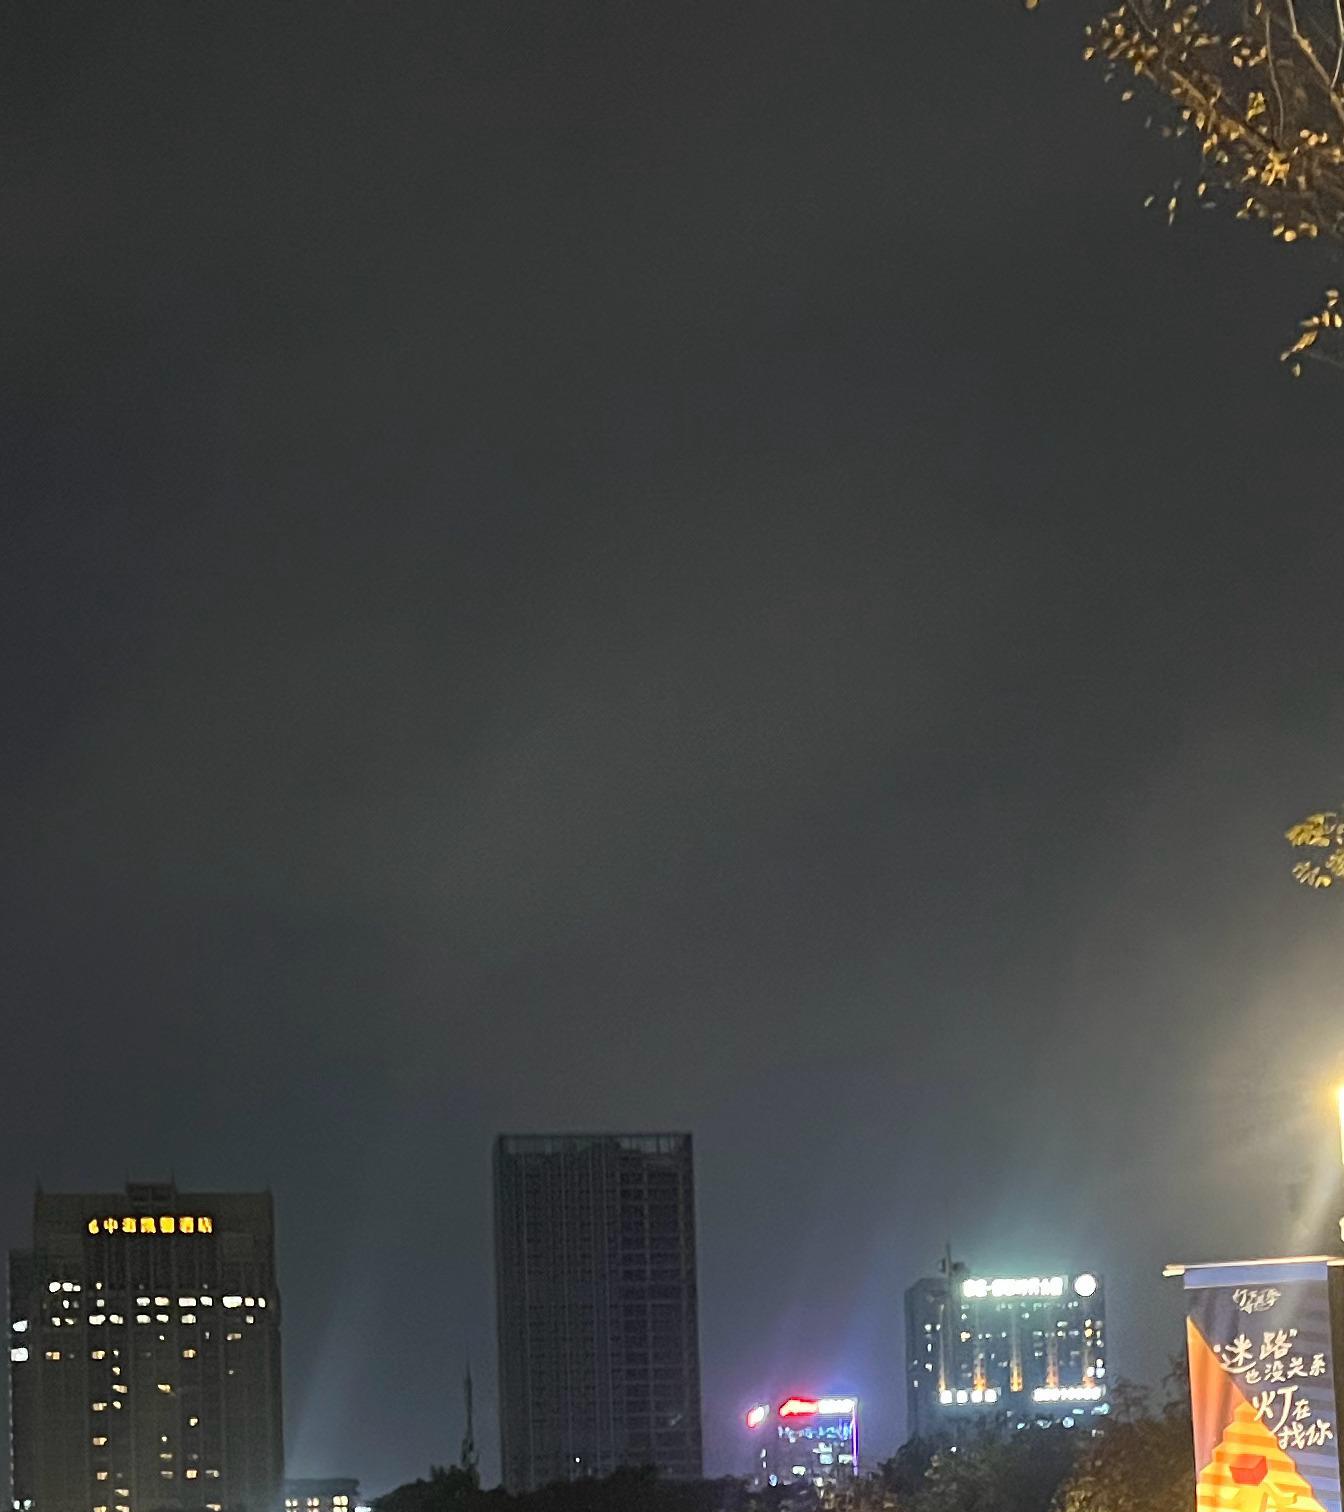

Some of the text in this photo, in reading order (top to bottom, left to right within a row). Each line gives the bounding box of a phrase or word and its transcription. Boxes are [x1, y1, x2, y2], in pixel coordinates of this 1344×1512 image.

[1245, 1353, 1326, 1384] 也没关系
[1277, 1418, 1334, 1450] 找你
